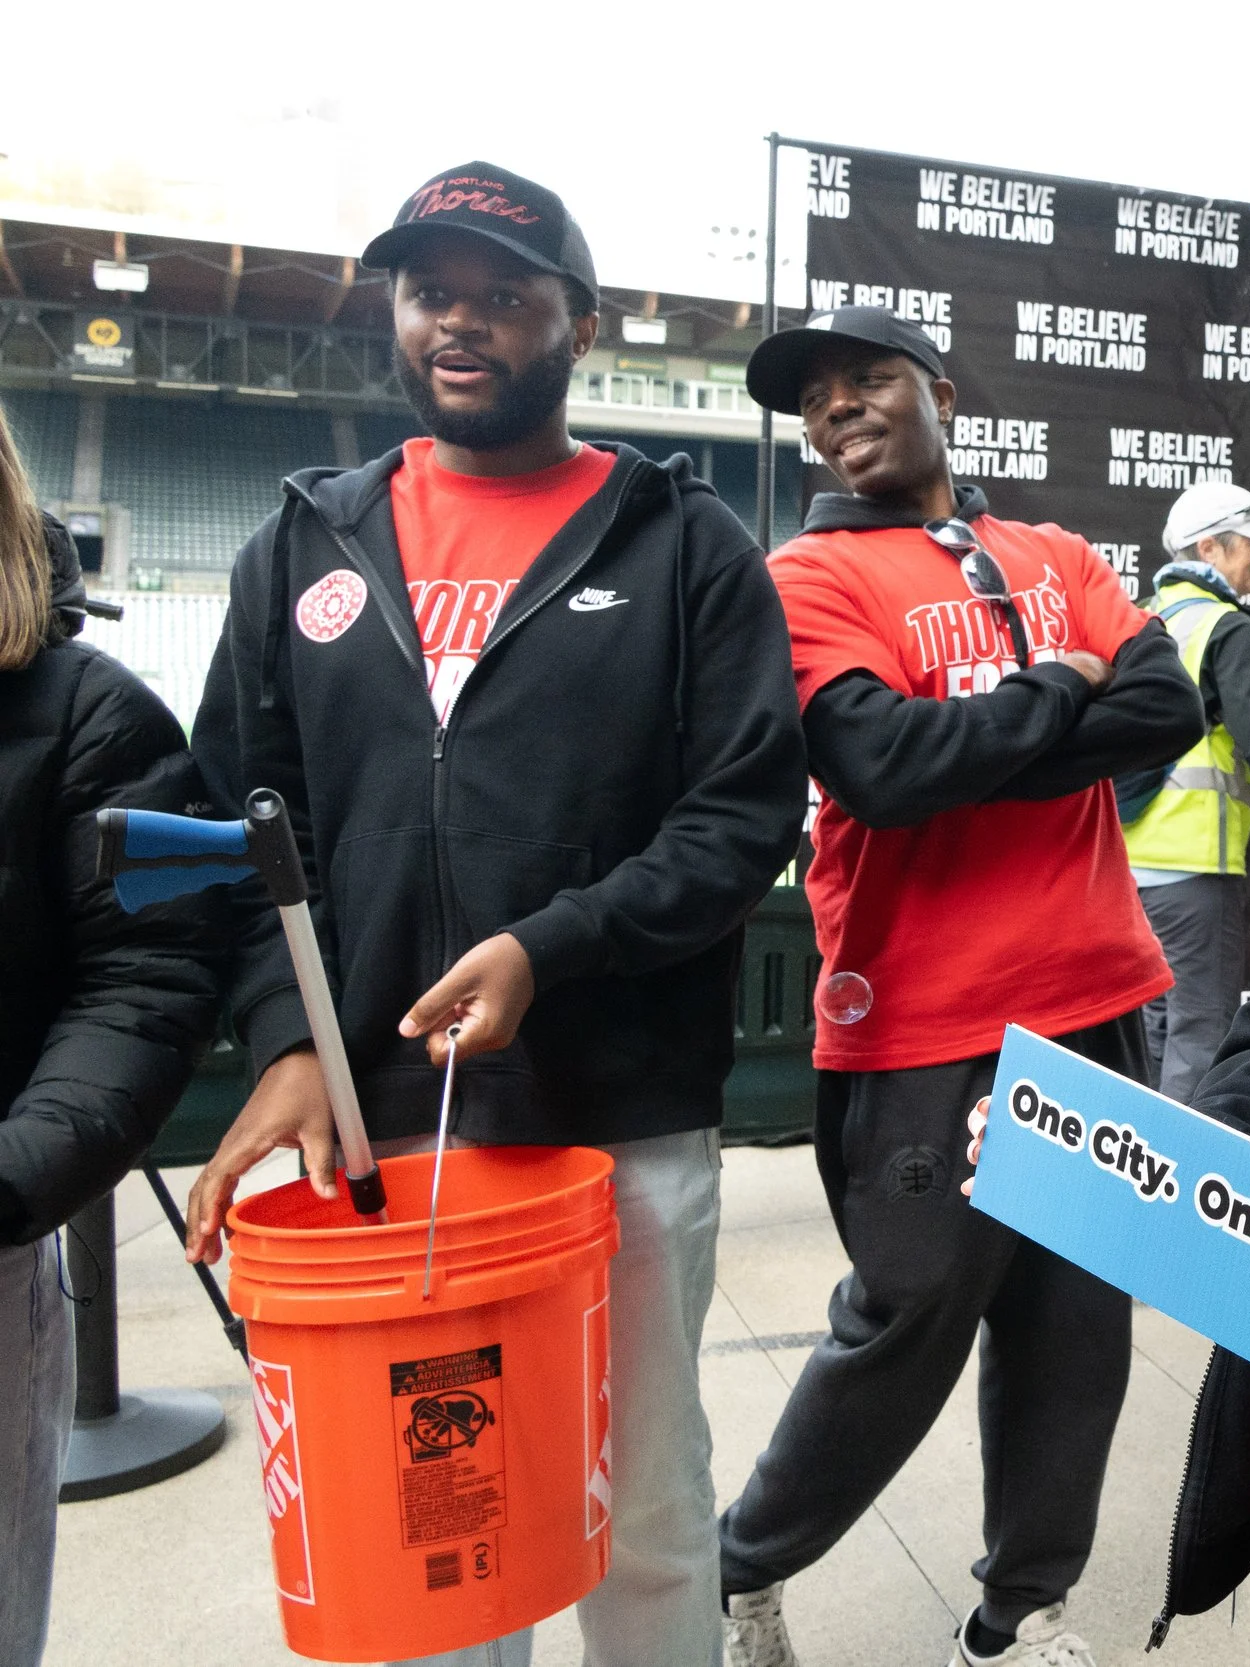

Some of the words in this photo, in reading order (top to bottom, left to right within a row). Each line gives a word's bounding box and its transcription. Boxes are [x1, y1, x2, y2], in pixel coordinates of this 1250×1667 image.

[407, 180, 541, 224] Thorns
[448, 177, 505, 191] PORTLAND
[919, 168, 958, 204] WE
[961, 174, 1057, 217] BELIEVE
[917, 202, 940, 231] IN
[945, 205, 1054, 245] PORTLAND
[1117, 197, 1152, 230] WE
[1154, 201, 1242, 242] BELIEVE
[1115, 227, 1137, 256] IN
[1141, 231, 1240, 269] PORTLAND
[810, 279, 849, 311] WE
[853, 283, 952, 324] BELIEVE
[1016, 301, 1054, 335] WE
[1057, 305, 1148, 345] BELIEVE
[1204, 322, 1238, 354] WE
[1015, 333, 1038, 362] IN
[1042, 336, 1147, 372] PORTLAND
[1202, 353, 1223, 380] IN
[954, 415, 1049, 452] BELIEVE
[1110, 427, 1145, 459] WE
[1148, 431, 1234, 467] BELIEVE
[1108, 459, 1130, 486] IN
[1134, 461, 1233, 490] PORTLAND
[579, 587, 617, 605] NIKE
[1012, 1084, 1083, 1147] One
[1093, 1124, 1176, 1197] City.
[417, 1360, 490, 1381] ADVERTENCIA
[426, 1351, 479, 1369] WARNING
[410, 1368, 497, 1393] AVERTISSEMENT
